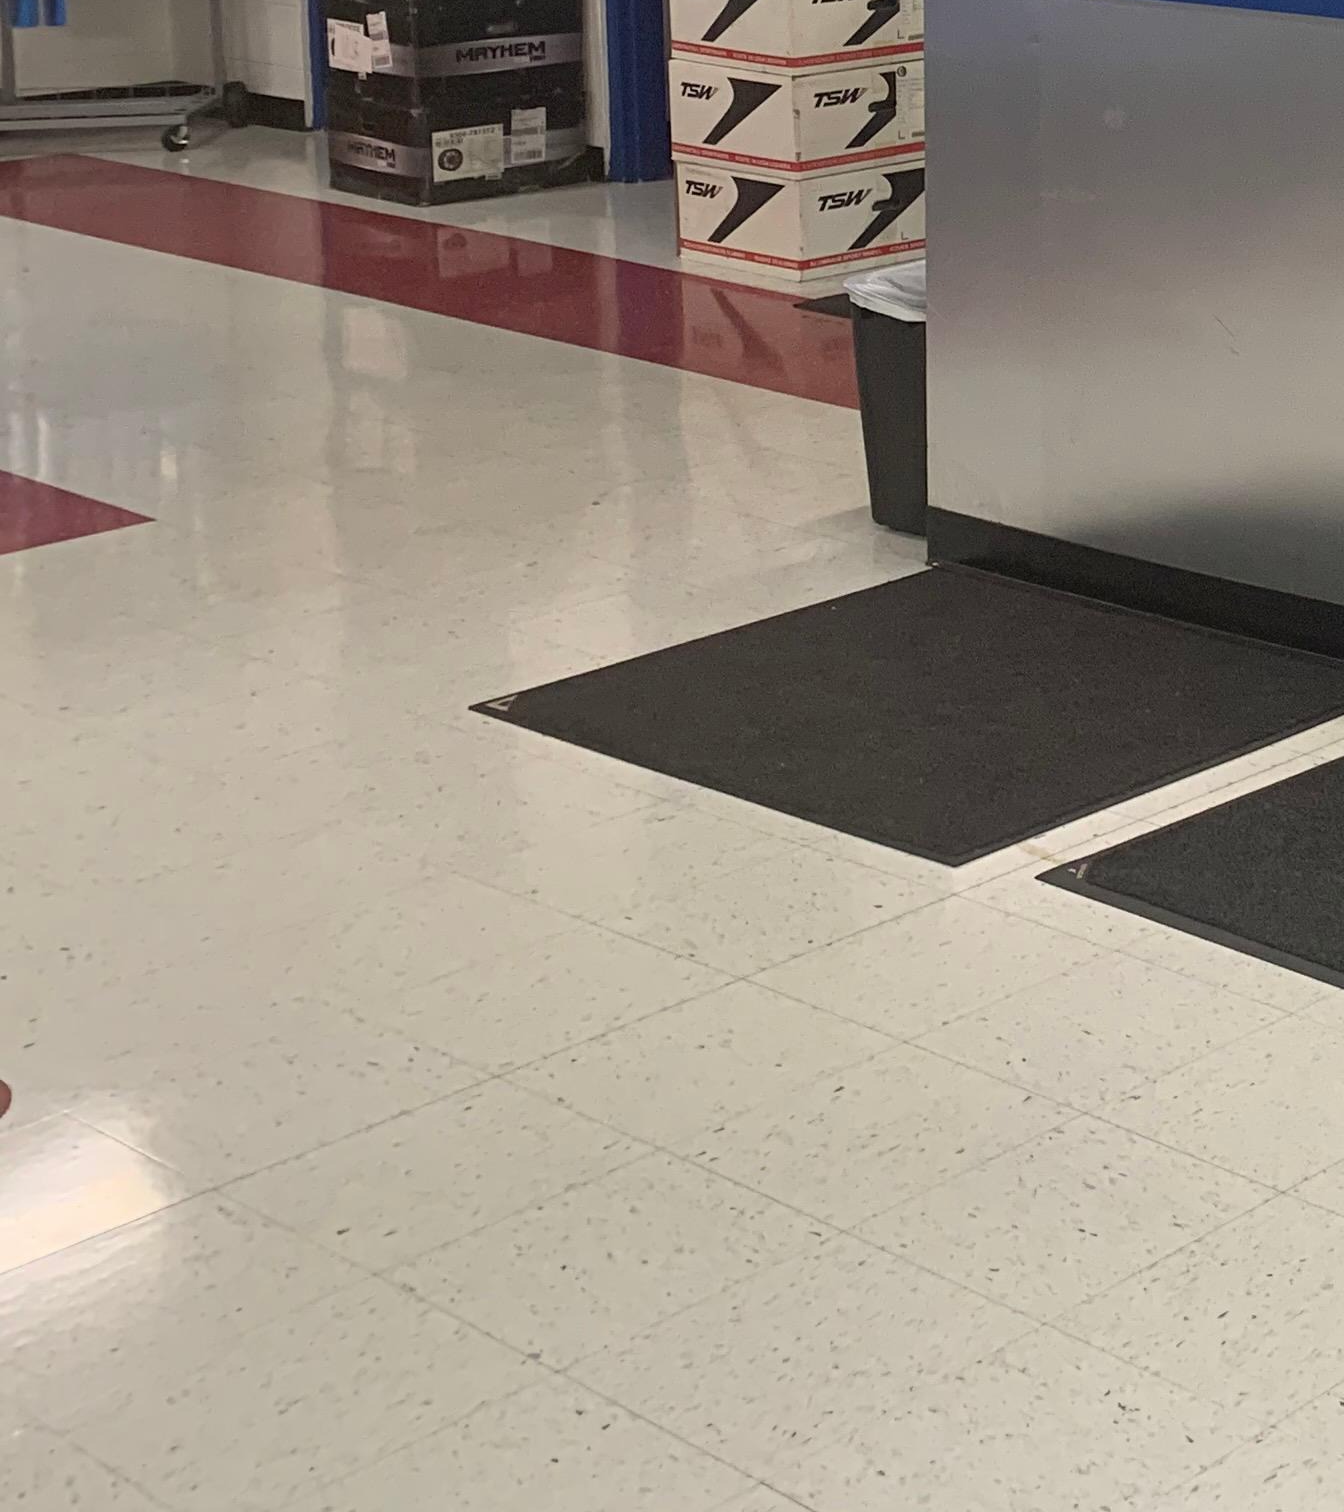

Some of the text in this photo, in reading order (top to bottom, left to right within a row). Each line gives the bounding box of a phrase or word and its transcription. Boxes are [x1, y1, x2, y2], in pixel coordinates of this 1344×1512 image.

[455, 40, 546, 64] MAYHEM
[680, 81, 868, 109] TSW TSW
[685, 180, 872, 212] TSW TSW
